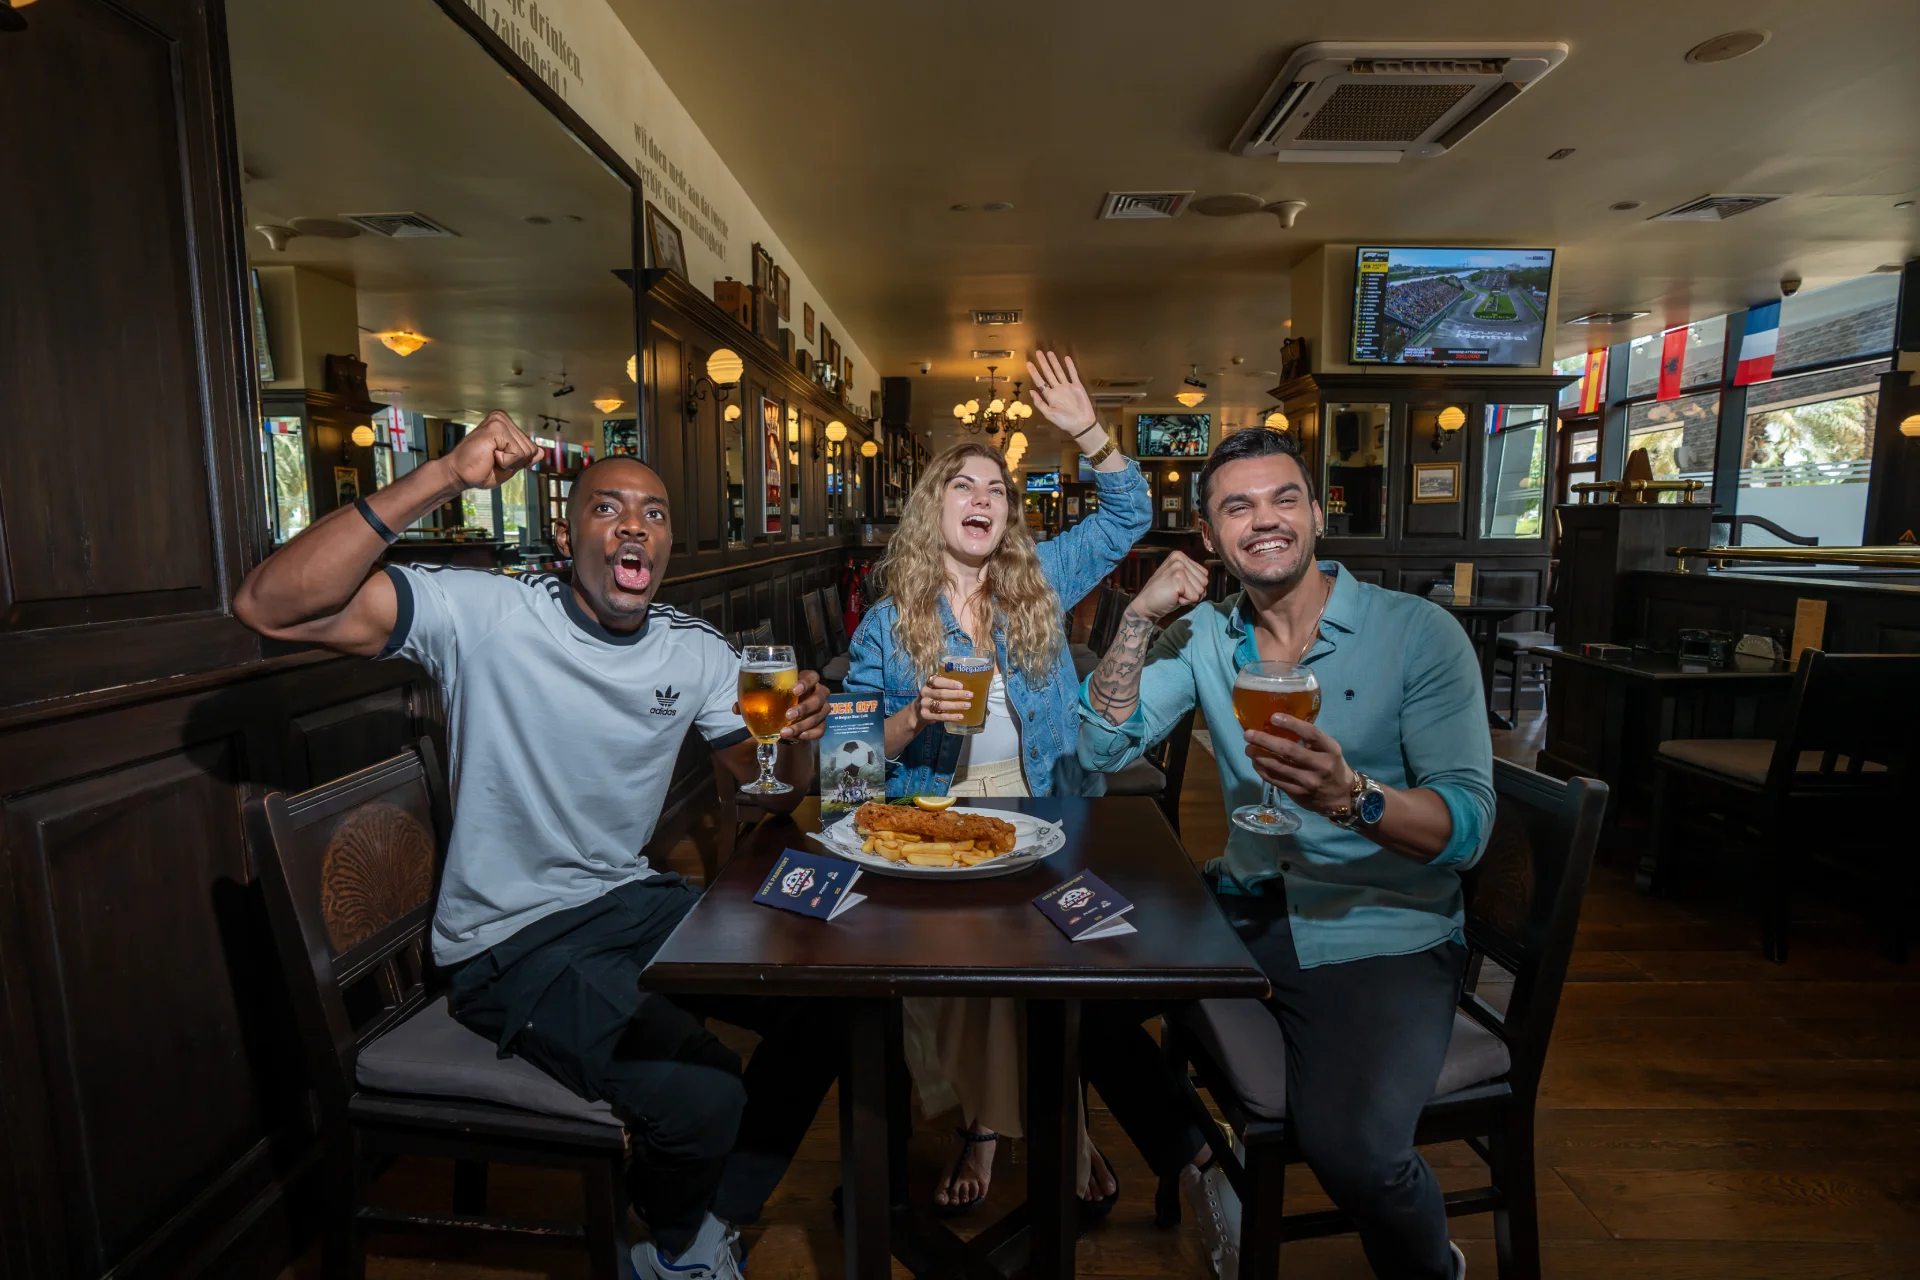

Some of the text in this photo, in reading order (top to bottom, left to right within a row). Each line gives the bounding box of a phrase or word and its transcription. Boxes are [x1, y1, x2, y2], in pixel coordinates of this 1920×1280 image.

[529, 0, 584, 87] drinken,
[634, 121, 647, 157] wij
[649, 135, 668, 174] doen
[664, 186, 677, 216] van
[650, 707, 677, 716] adidas
[856, 701, 878, 713] OFF
